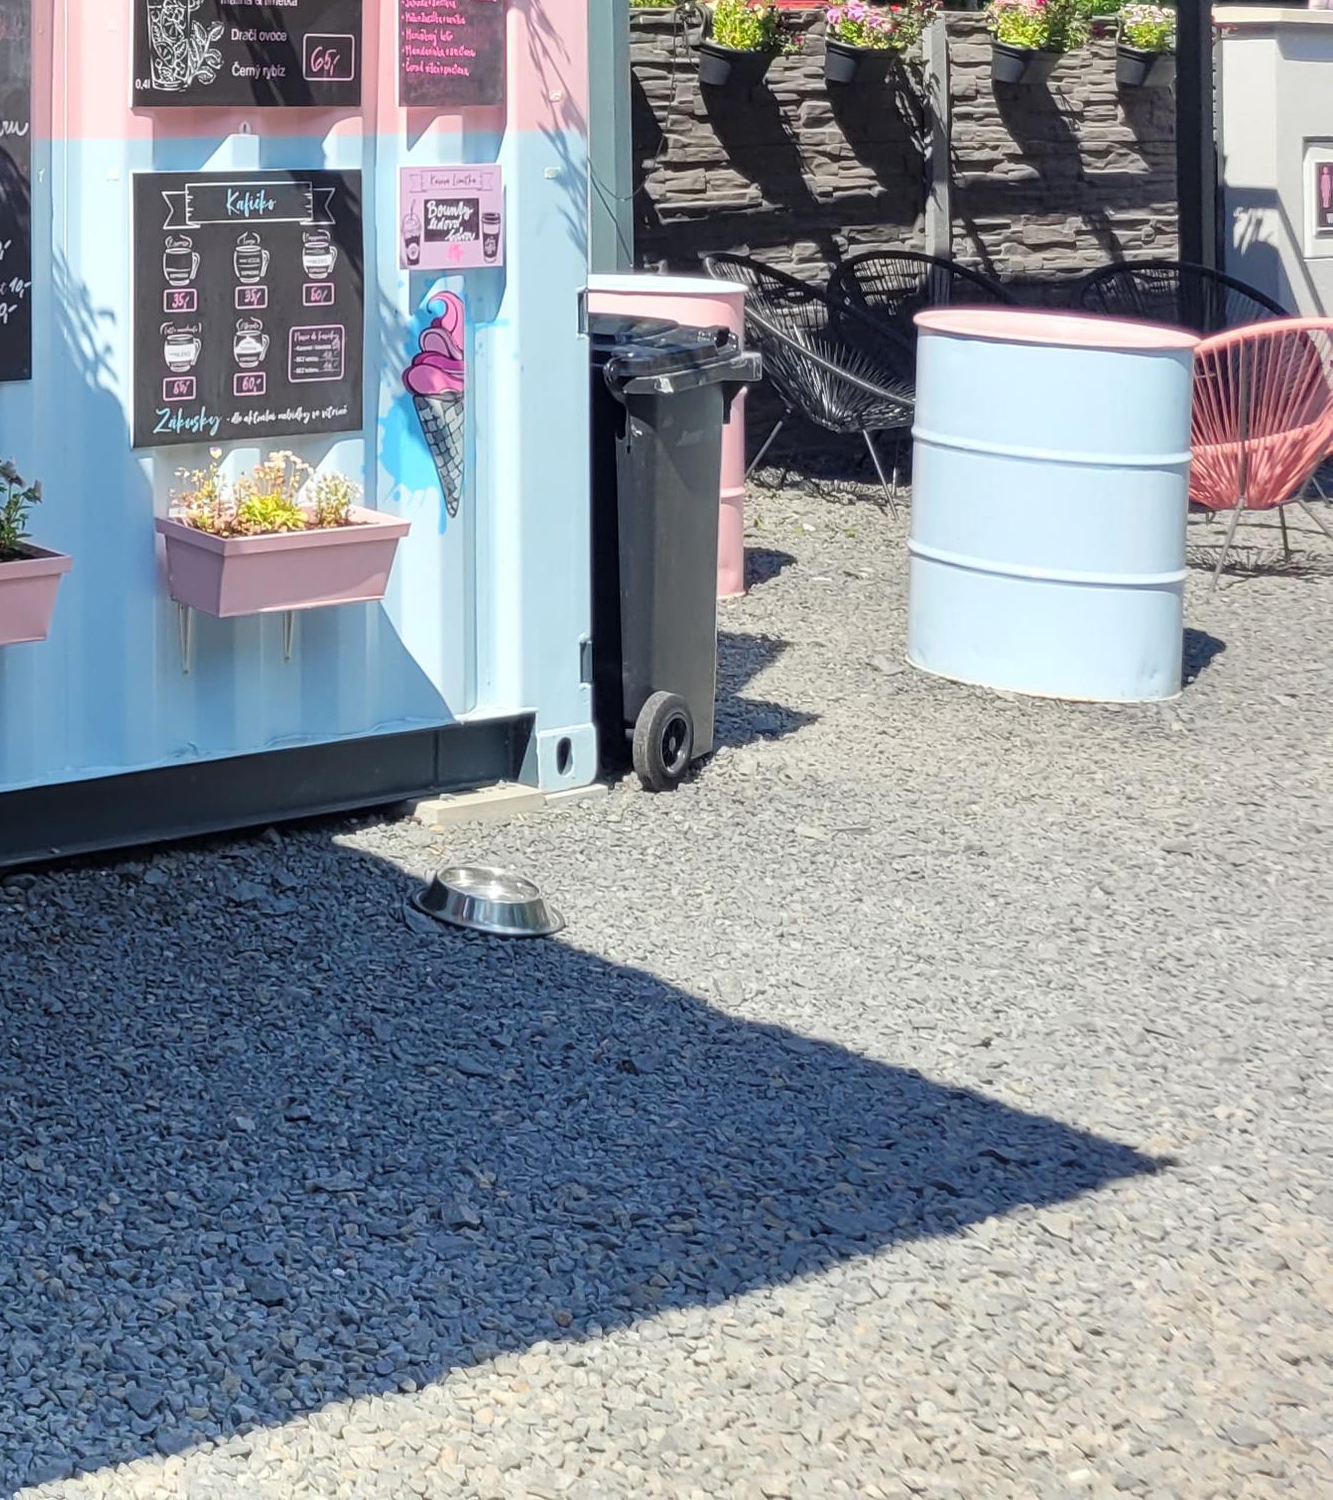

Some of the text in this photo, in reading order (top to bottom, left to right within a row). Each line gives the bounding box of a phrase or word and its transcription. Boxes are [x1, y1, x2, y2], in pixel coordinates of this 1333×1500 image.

[230, 27, 288, 42] Dračí ovoce
[230, 61, 287, 81] Černý rybíz
